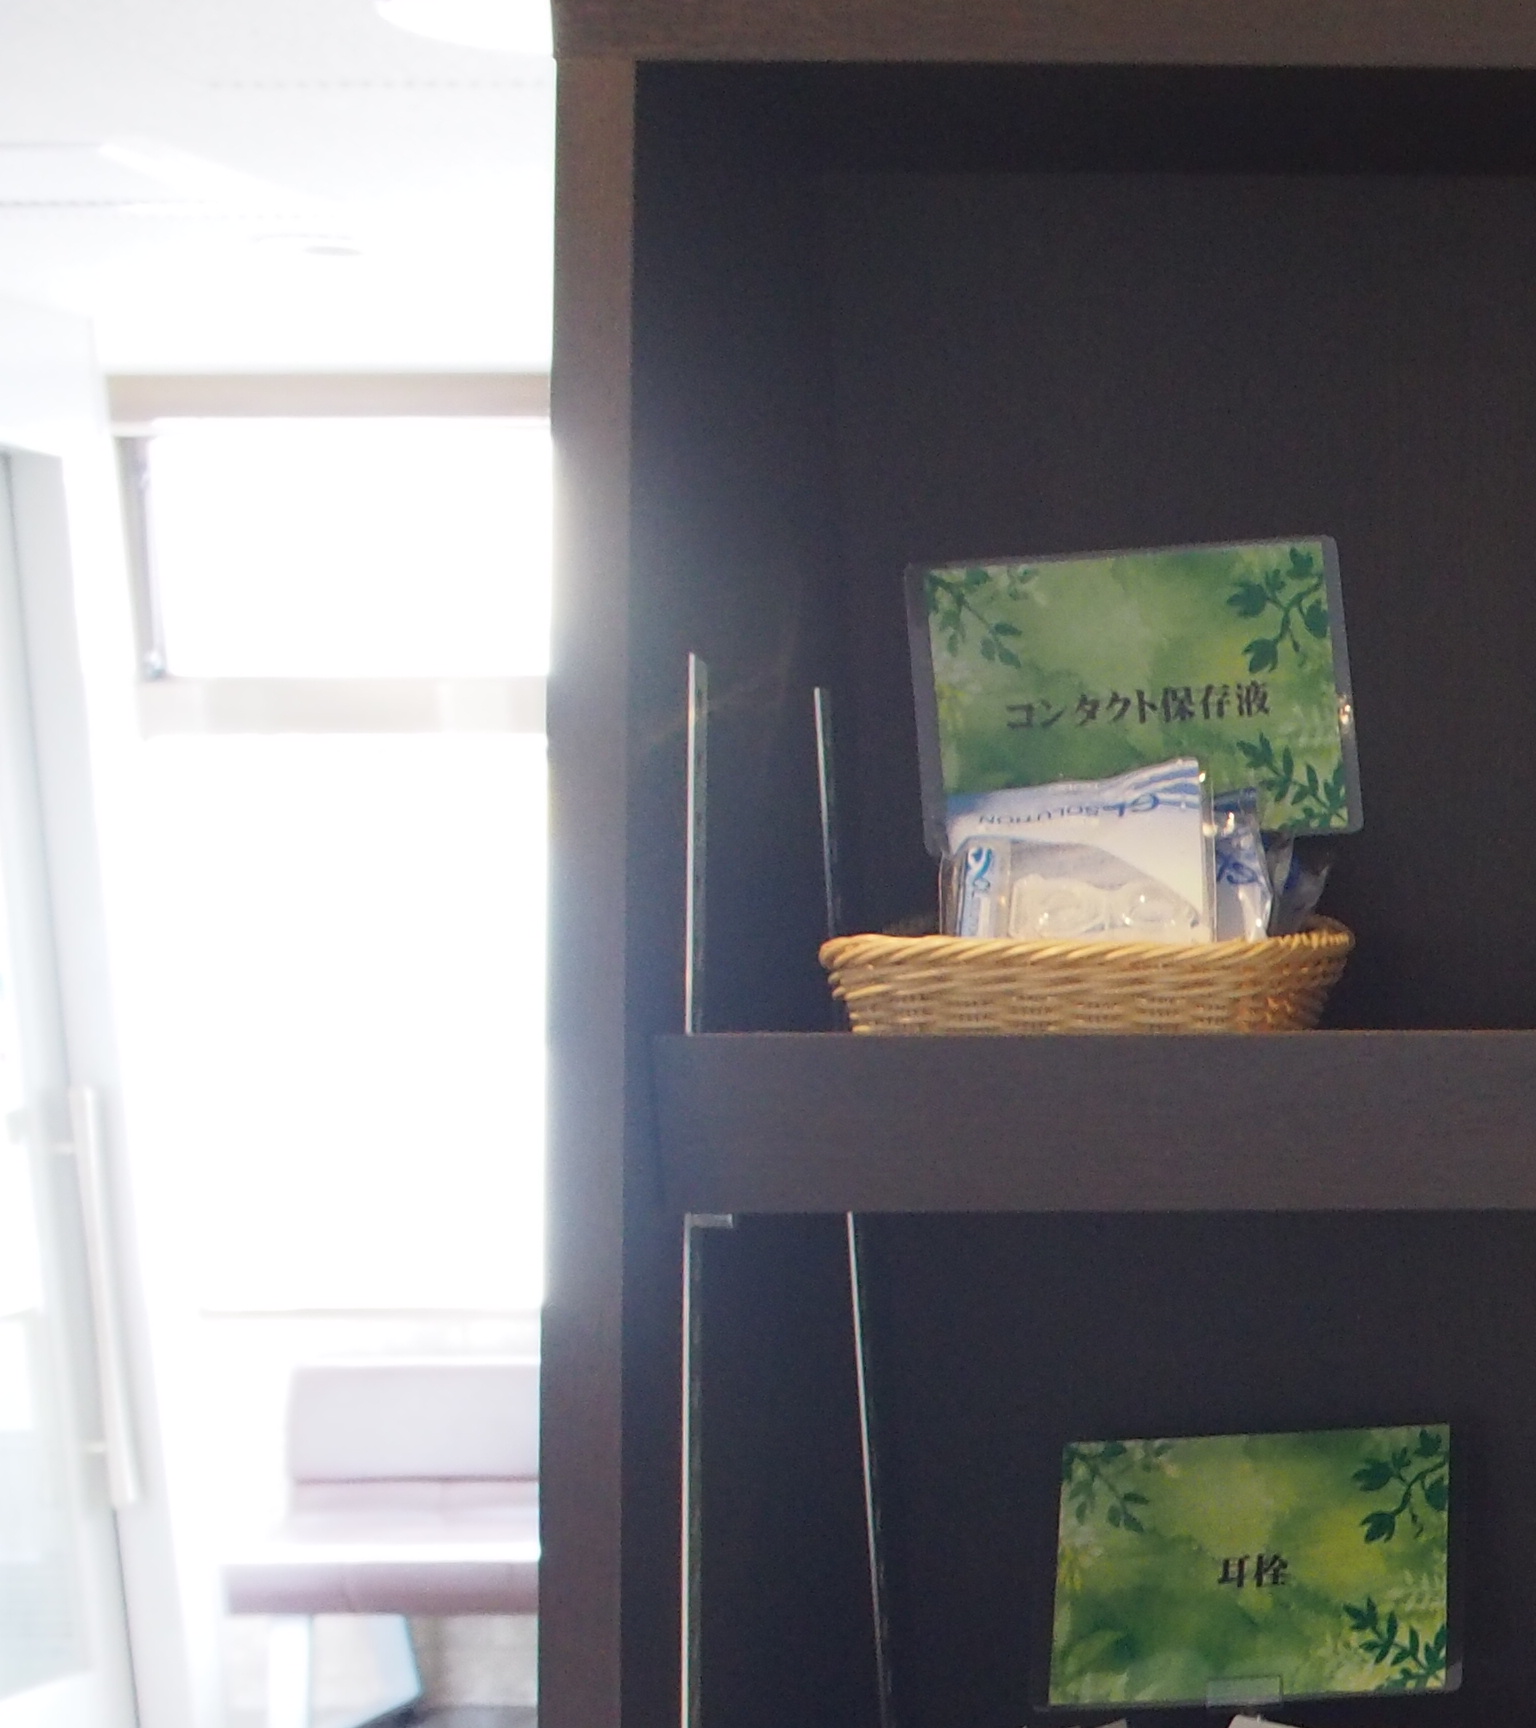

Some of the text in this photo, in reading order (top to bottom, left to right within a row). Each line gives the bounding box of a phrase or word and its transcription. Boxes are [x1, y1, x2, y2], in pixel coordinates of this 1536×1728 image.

[1005, 679, 1272, 731] コンタクト保存液
[1216, 1551, 1290, 1589] 耳栓
